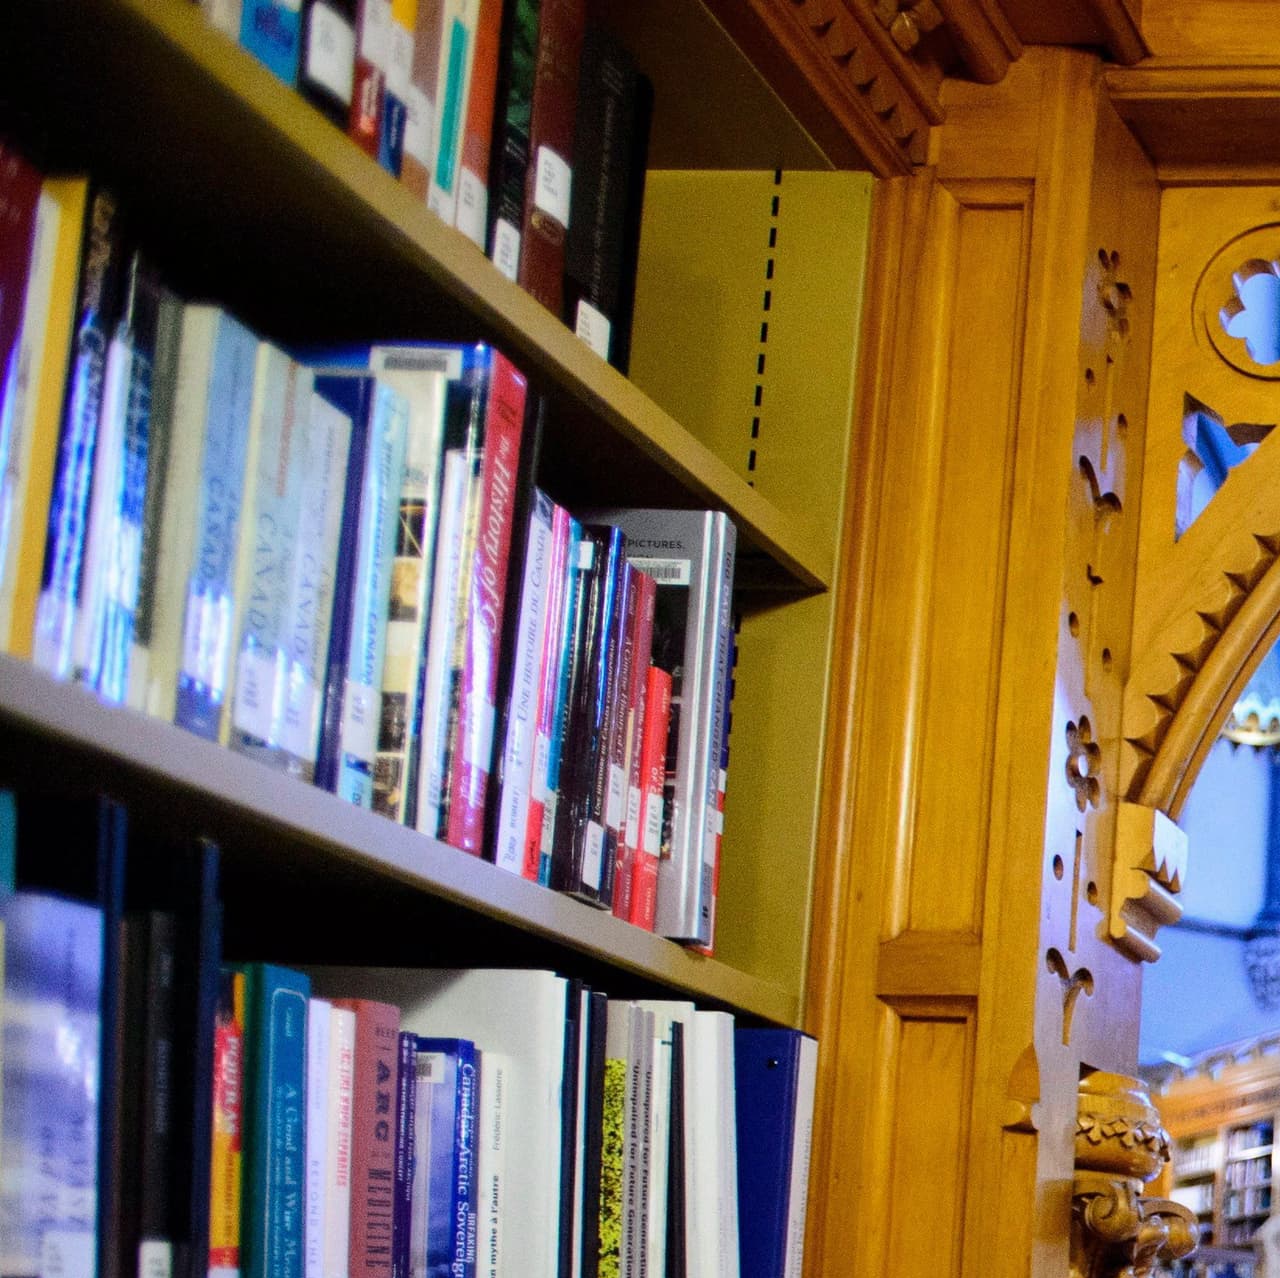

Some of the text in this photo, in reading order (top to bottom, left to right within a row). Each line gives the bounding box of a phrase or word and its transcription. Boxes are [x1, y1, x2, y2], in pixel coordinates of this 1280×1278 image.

[201, 476, 225, 592] CANAD
[483, 463, 512, 567] History
[531, 528, 546, 588] CANADA
[627, 540, 685, 550] PICTURES.
[374, 1059, 392, 1142] ARC
[457, 1144, 473, 1196] Arctic
[491, 1174, 501, 1215] l'autre
[617, 1163, 633, 1206] Future
[365, 1168, 392, 1268] MEDICINE
[465, 1213, 477, 1264] BREAKING
[489, 1228, 499, 1265] mythe
